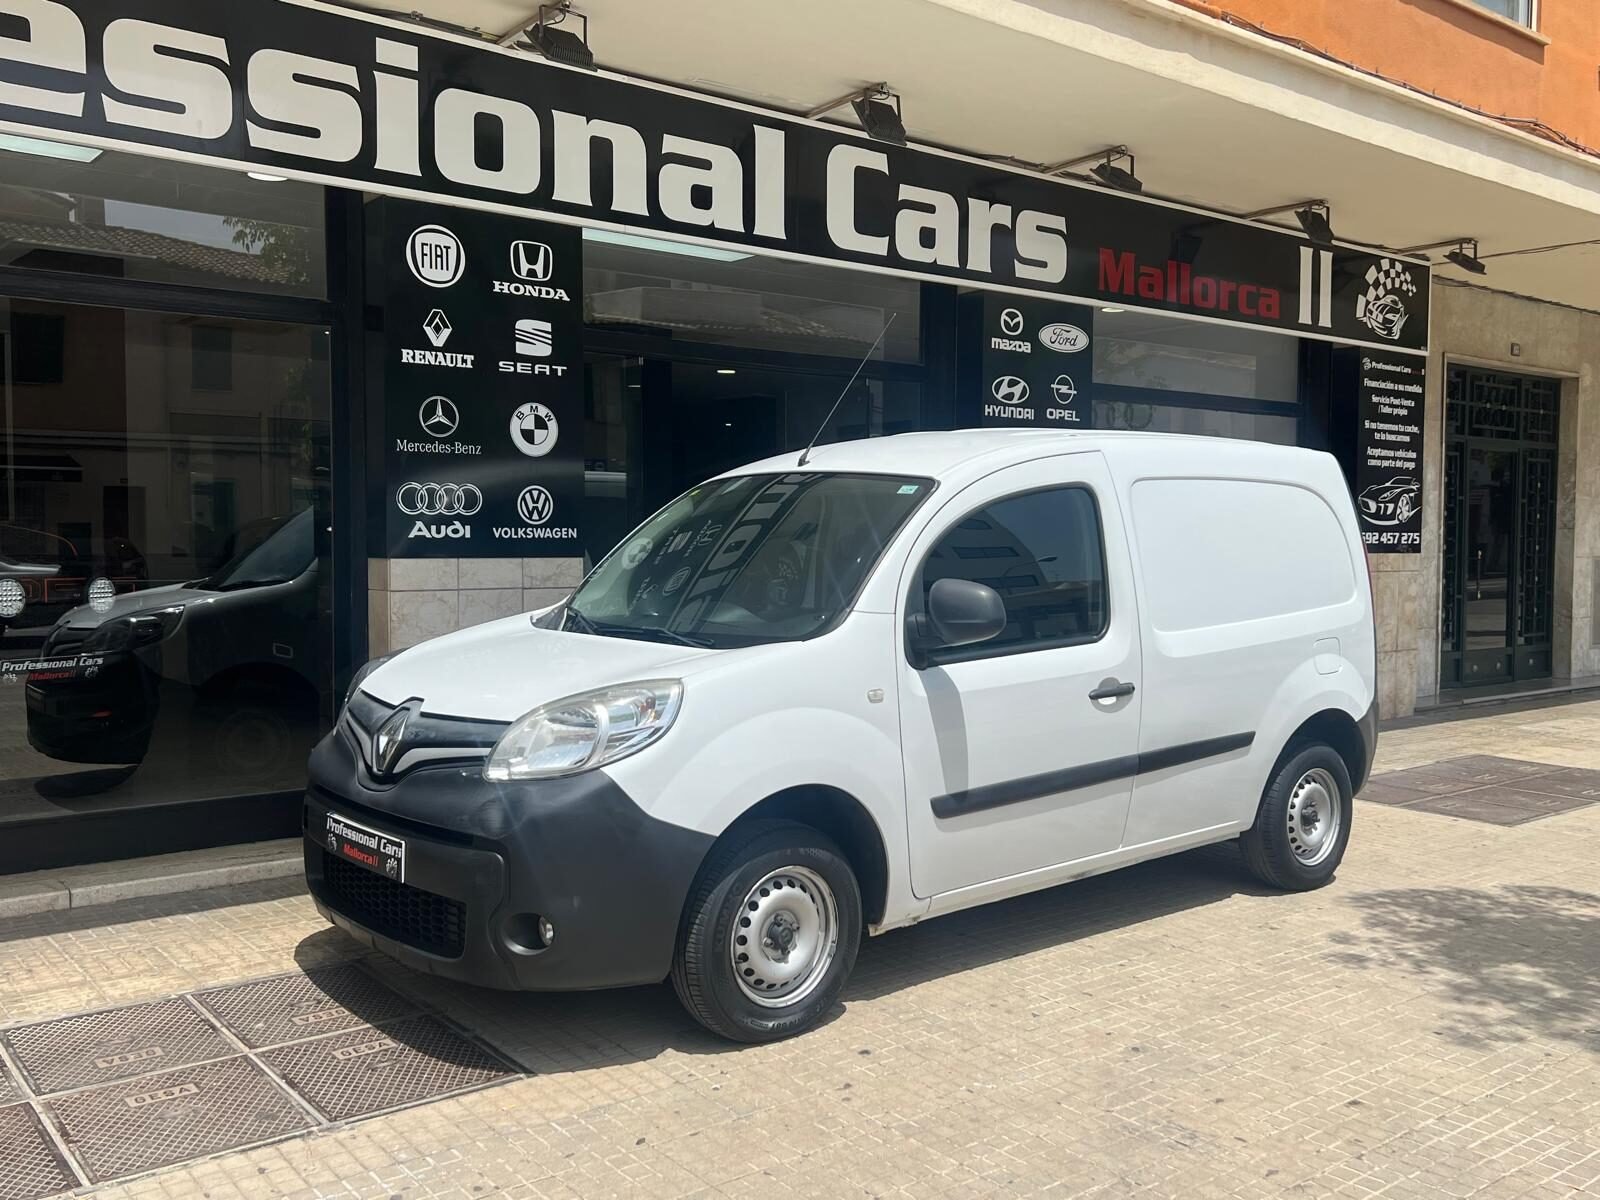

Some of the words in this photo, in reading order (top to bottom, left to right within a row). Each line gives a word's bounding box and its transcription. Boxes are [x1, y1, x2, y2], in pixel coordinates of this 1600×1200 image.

[827, 144, 1068, 284] Cars
[1097, 247, 1281, 320] Mallorca
[421, 242, 452, 271] FIAT
[492, 280, 571, 301] HONDA
[991, 337, 1032, 353] mazda
[1049, 327, 1079, 347] Ford
[401, 349, 475, 369] RENAULT
[1371, 361, 1401, 372] Professional
[498, 361, 568, 377] SEAT
[1405, 384, 1423, 393] medida
[1371, 394, 1390, 404] Servicio
[1390, 397, 1415, 407] Post-Venta
[514, 405, 554, 423] BMW
[984, 404, 1035, 420] HYUNDAI
[1046, 408, 1081, 421] OPEL
[1393, 408, 1408, 416] propio
[1377, 422, 1398, 431] tenemos
[1386, 433, 1410, 443] buscamos
[396, 439, 482, 455] Mercedes-Benz
[1366, 446, 1394, 458] Aceptamos
[1381, 459, 1395, 468] parte
[1403, 461, 1416, 470] pago
[408, 520, 471, 539] Audi
[492, 527, 578, 539] VOLKSWAGEN
[1380, 532, 1400, 544] 457
[1401, 532, 1420, 544] 275
[2, 657, 77, 672] Professional
[79, 656, 104, 666] Cars
[326, 817, 379, 850] Professional
[343, 843, 372, 865] Mallorca
[133, 1085, 191, 1104] GESA
